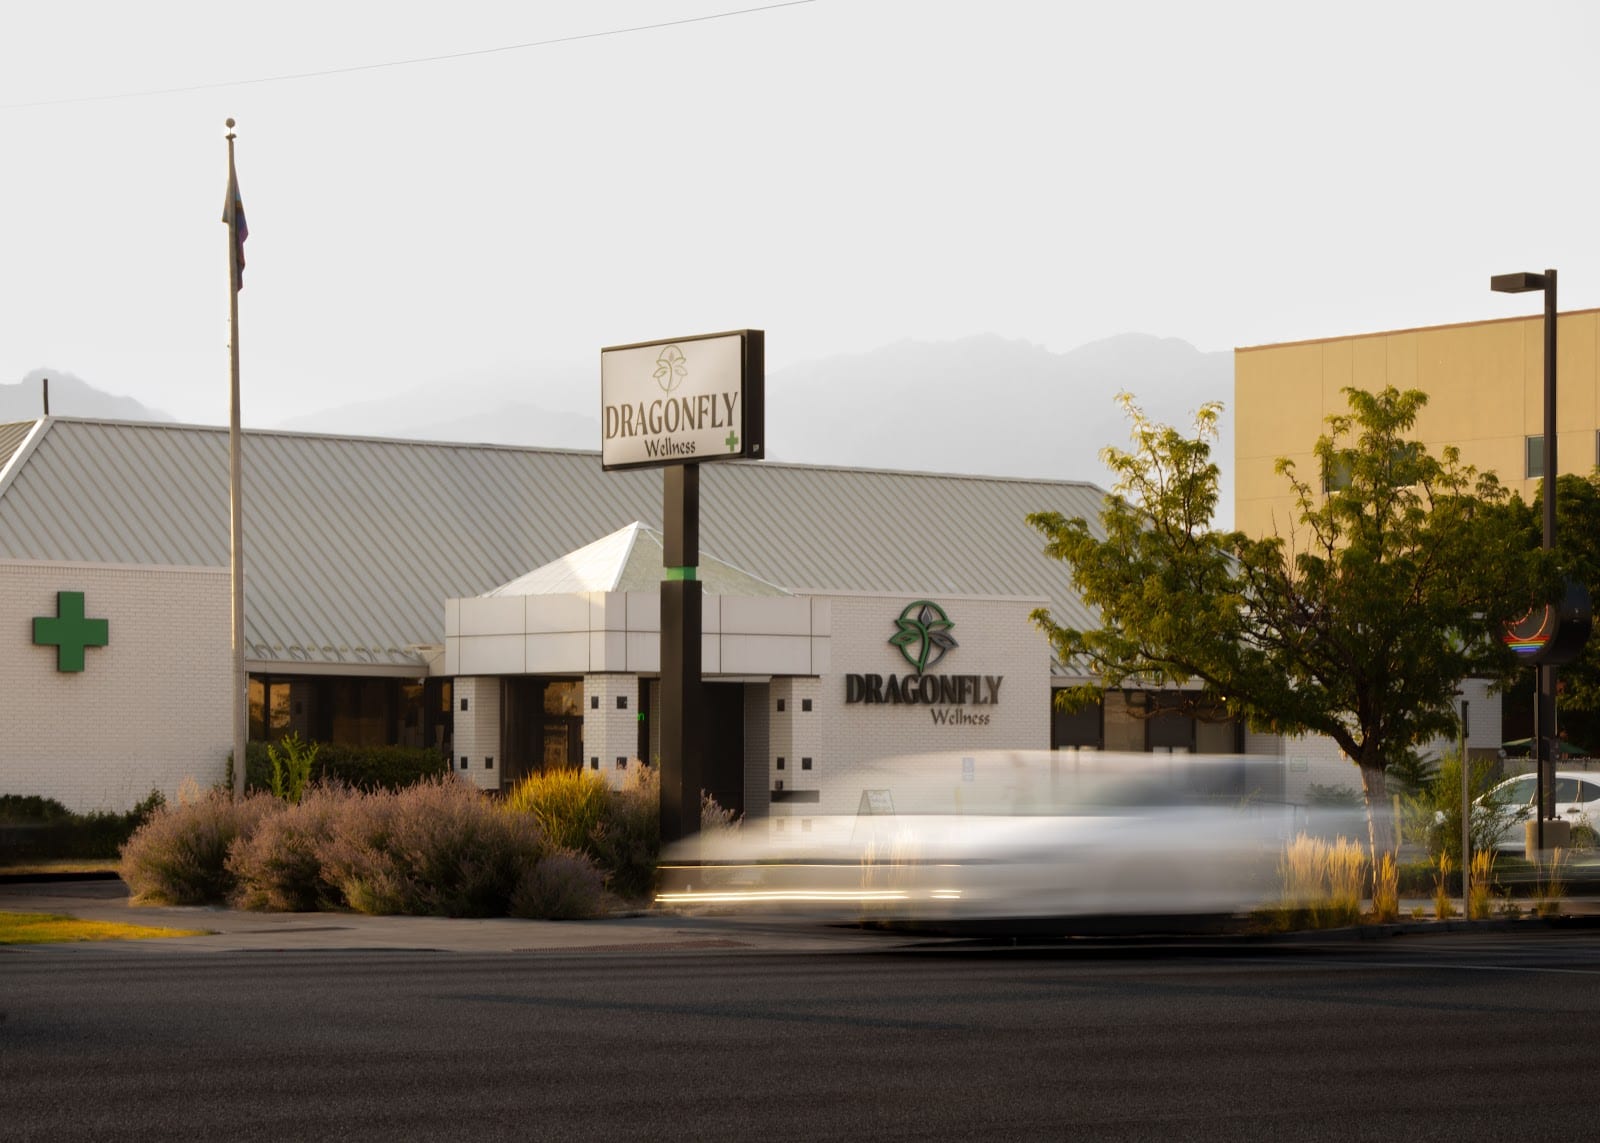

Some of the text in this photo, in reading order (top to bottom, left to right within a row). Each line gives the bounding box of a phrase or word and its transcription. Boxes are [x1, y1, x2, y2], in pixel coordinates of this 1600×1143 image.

[605, 392, 738, 440] DRAGONFLY
[644, 437, 696, 457] Wellness
[845, 673, 1003, 705] DRAGONFLY
[930, 708, 990, 726] Wellness
